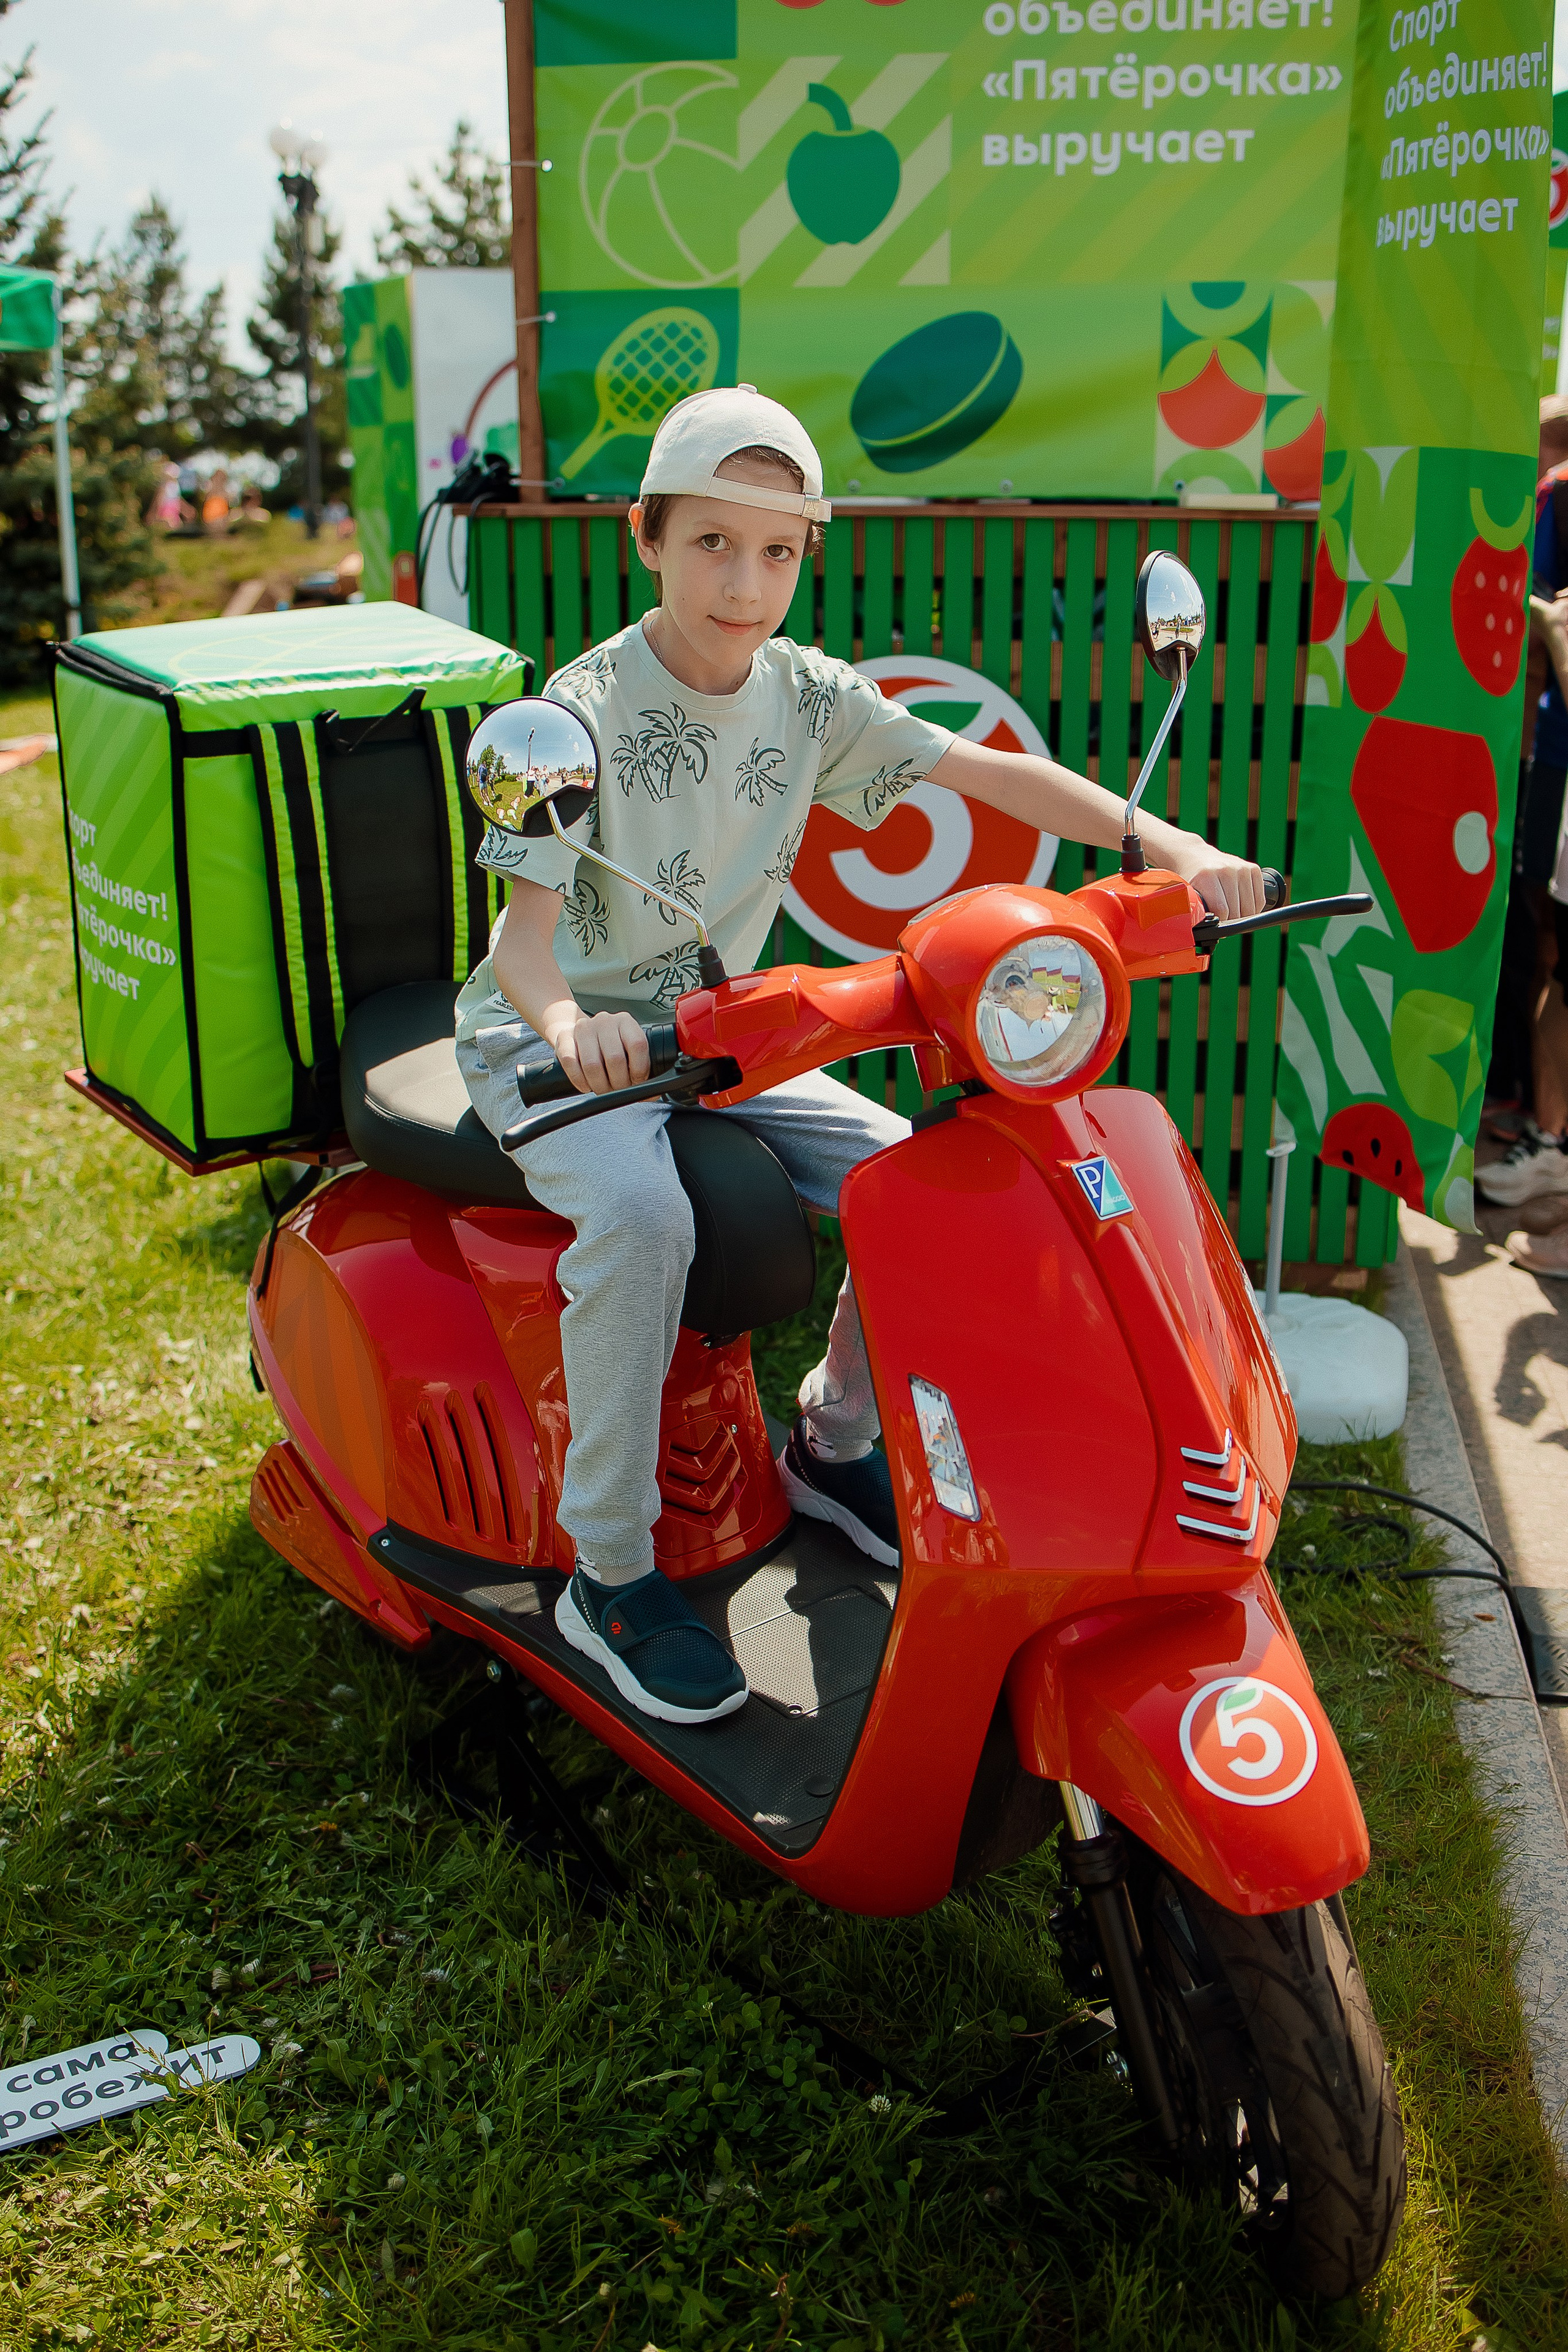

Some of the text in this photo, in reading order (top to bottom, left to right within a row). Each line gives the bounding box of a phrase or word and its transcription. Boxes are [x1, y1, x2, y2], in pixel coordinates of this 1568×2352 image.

[983, 0, 1333, 36] объединяет!
[1390, 0, 1461, 52] Спорт
[982, 53, 1343, 109] «Пятёрочка»
[1384, 41, 1548, 119] объединяет!
[983, 129, 1254, 176] выручает
[1381, 121, 1550, 179] «Пятёрочка»
[493, 1000, 514, 1011] FEARLESS
[1079, 1166, 1101, 1199] P
[1215, 1686, 1284, 1780] 5
[7, 2041, 139, 2093] сама
